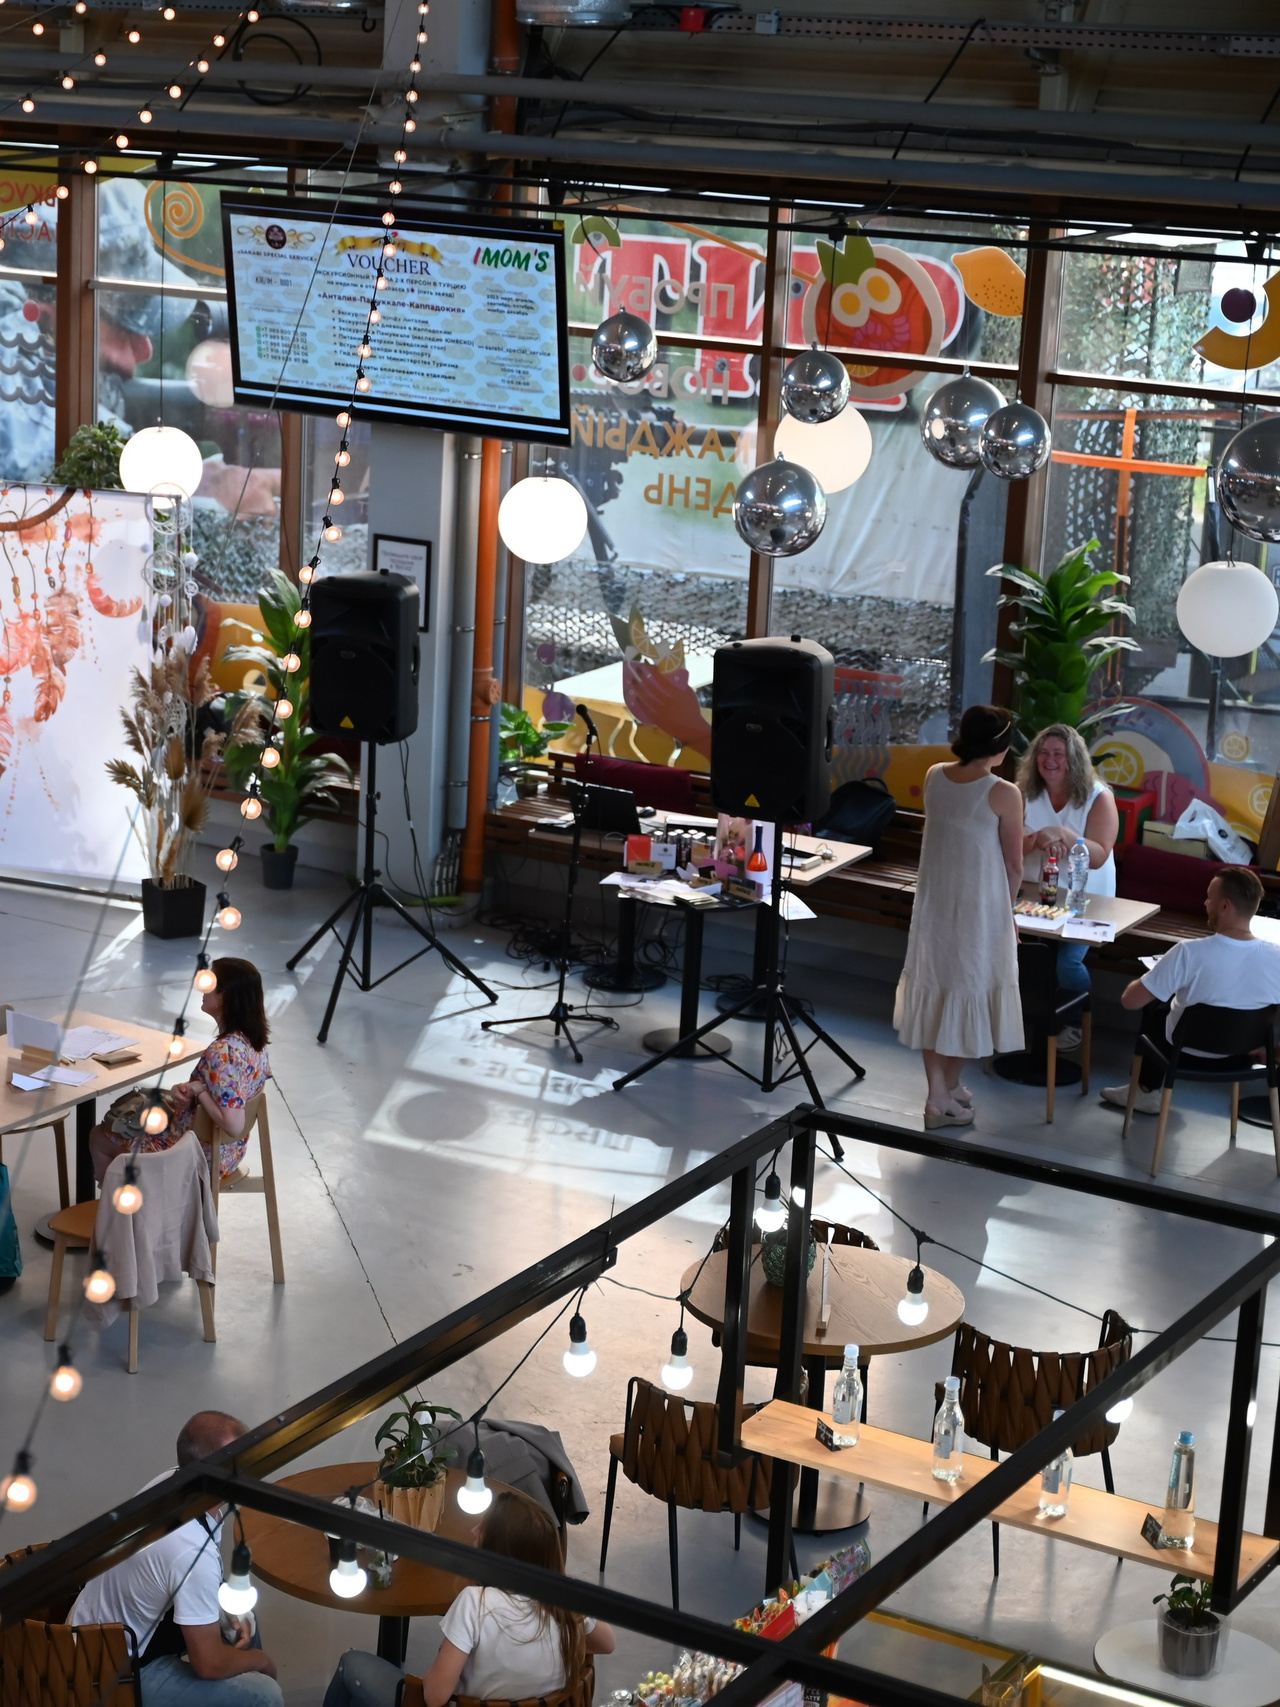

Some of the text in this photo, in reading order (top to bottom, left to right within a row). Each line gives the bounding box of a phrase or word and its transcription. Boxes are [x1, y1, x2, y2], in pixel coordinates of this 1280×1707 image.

[347, 253, 431, 276] VOUCHER
[438, 281, 466, 291] ТУРЦИЮ
[317, 290, 465, 314] «Анталия-Пауккале-Каппадокия»
[432, 360, 458, 370] Туризма
